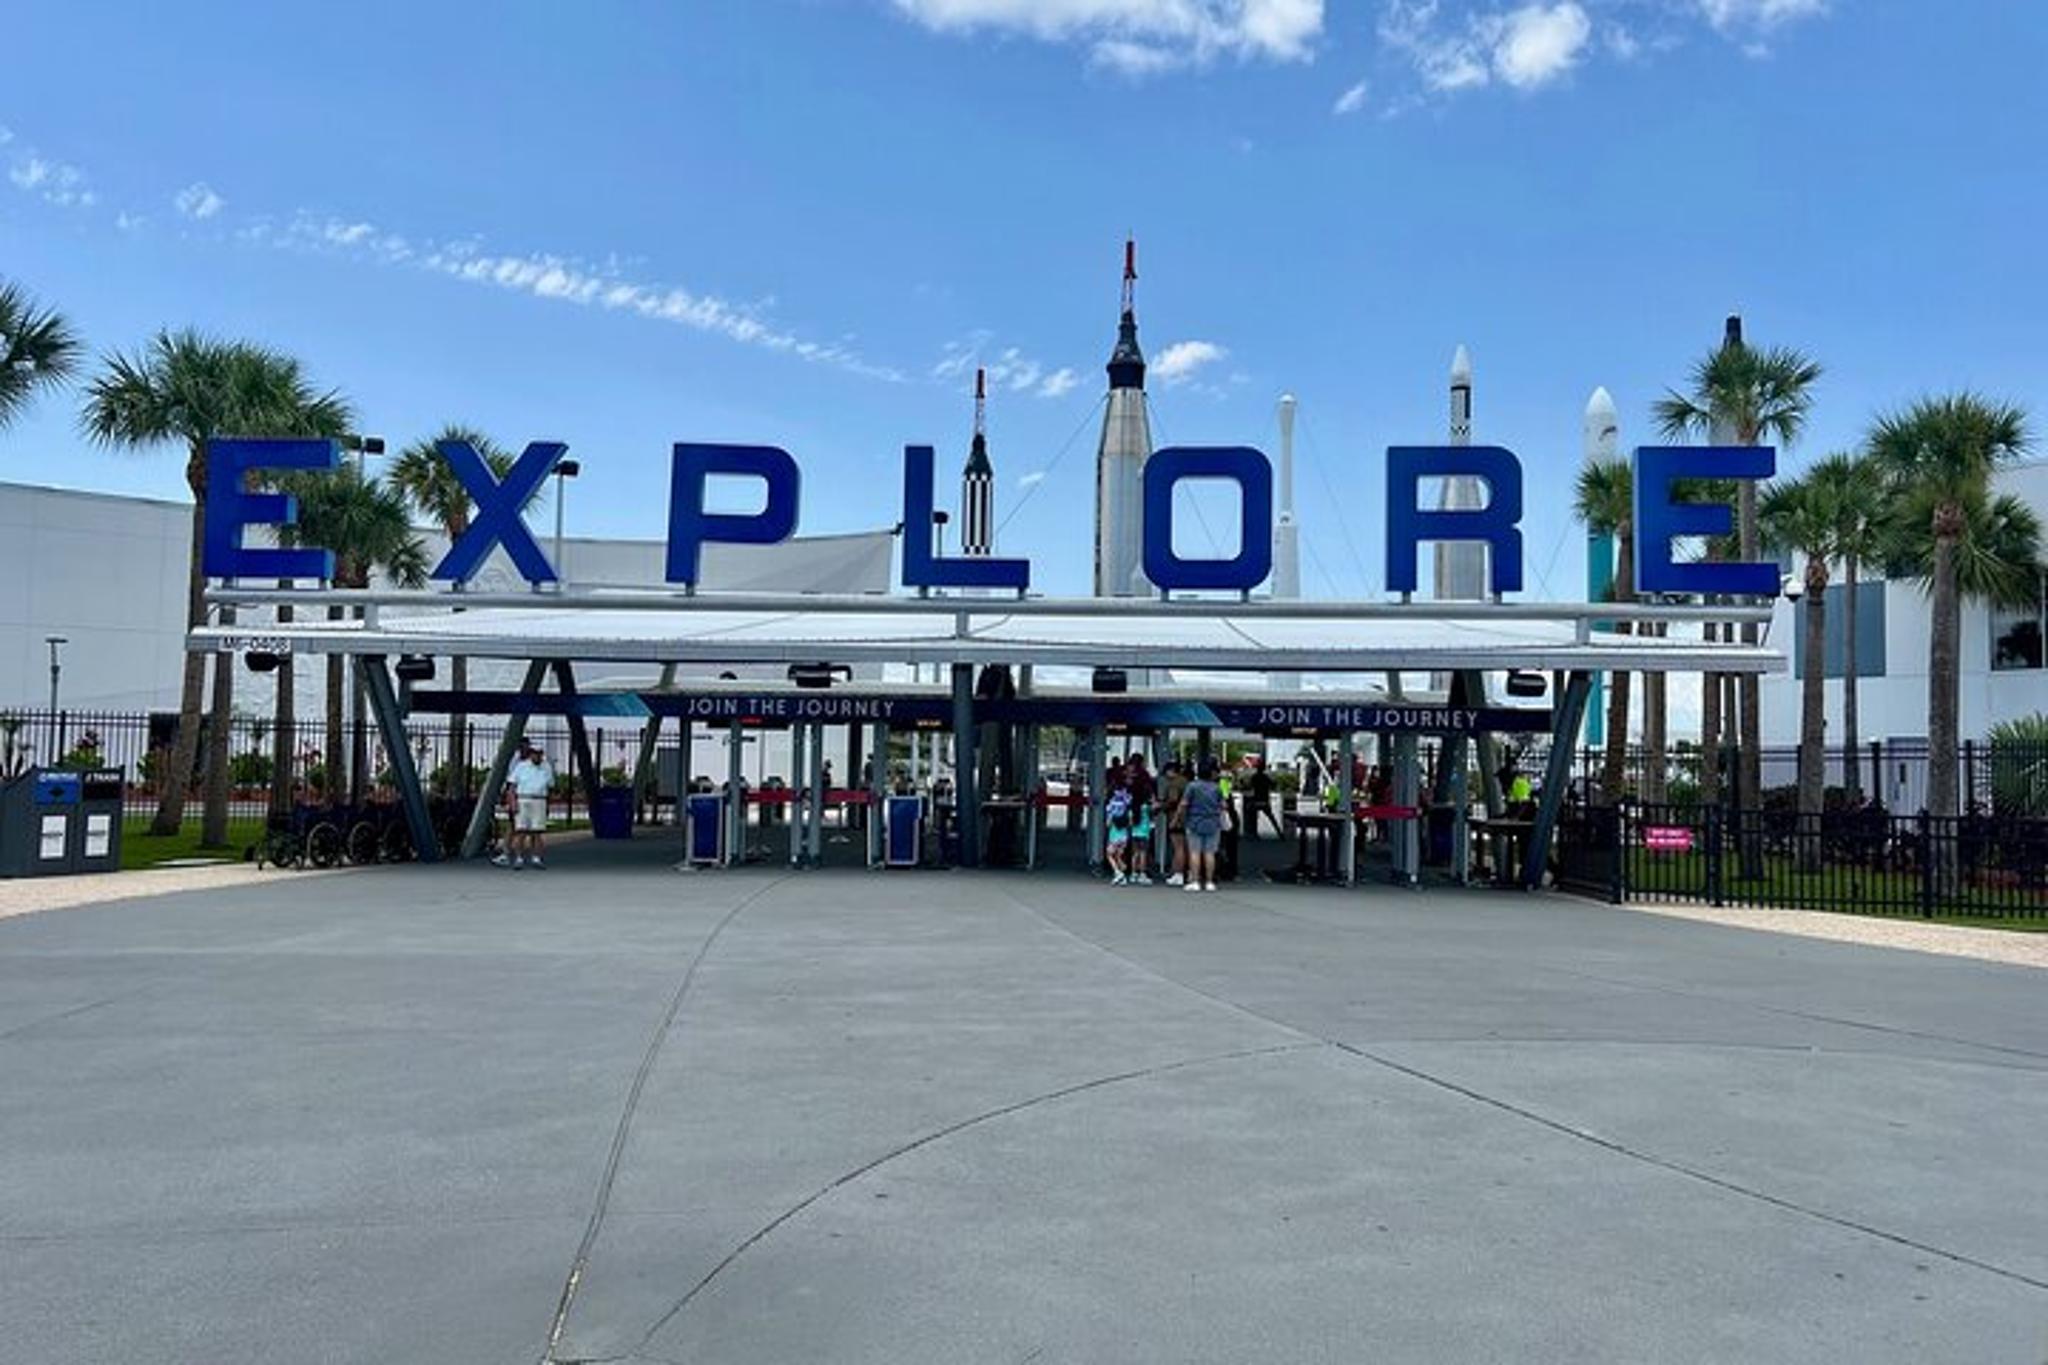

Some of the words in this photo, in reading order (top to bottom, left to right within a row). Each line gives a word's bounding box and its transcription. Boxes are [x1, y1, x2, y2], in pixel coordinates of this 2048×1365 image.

[203, 438, 1780, 595] EXPLORE
[688, 699, 737, 714] JOIN
[749, 699, 786, 715] THE
[796, 699, 894, 717] JOURNEY
[1259, 708, 1310, 724] JOIN
[1322, 708, 1362, 726] THE
[1373, 709, 1478, 728] JOURNEY
